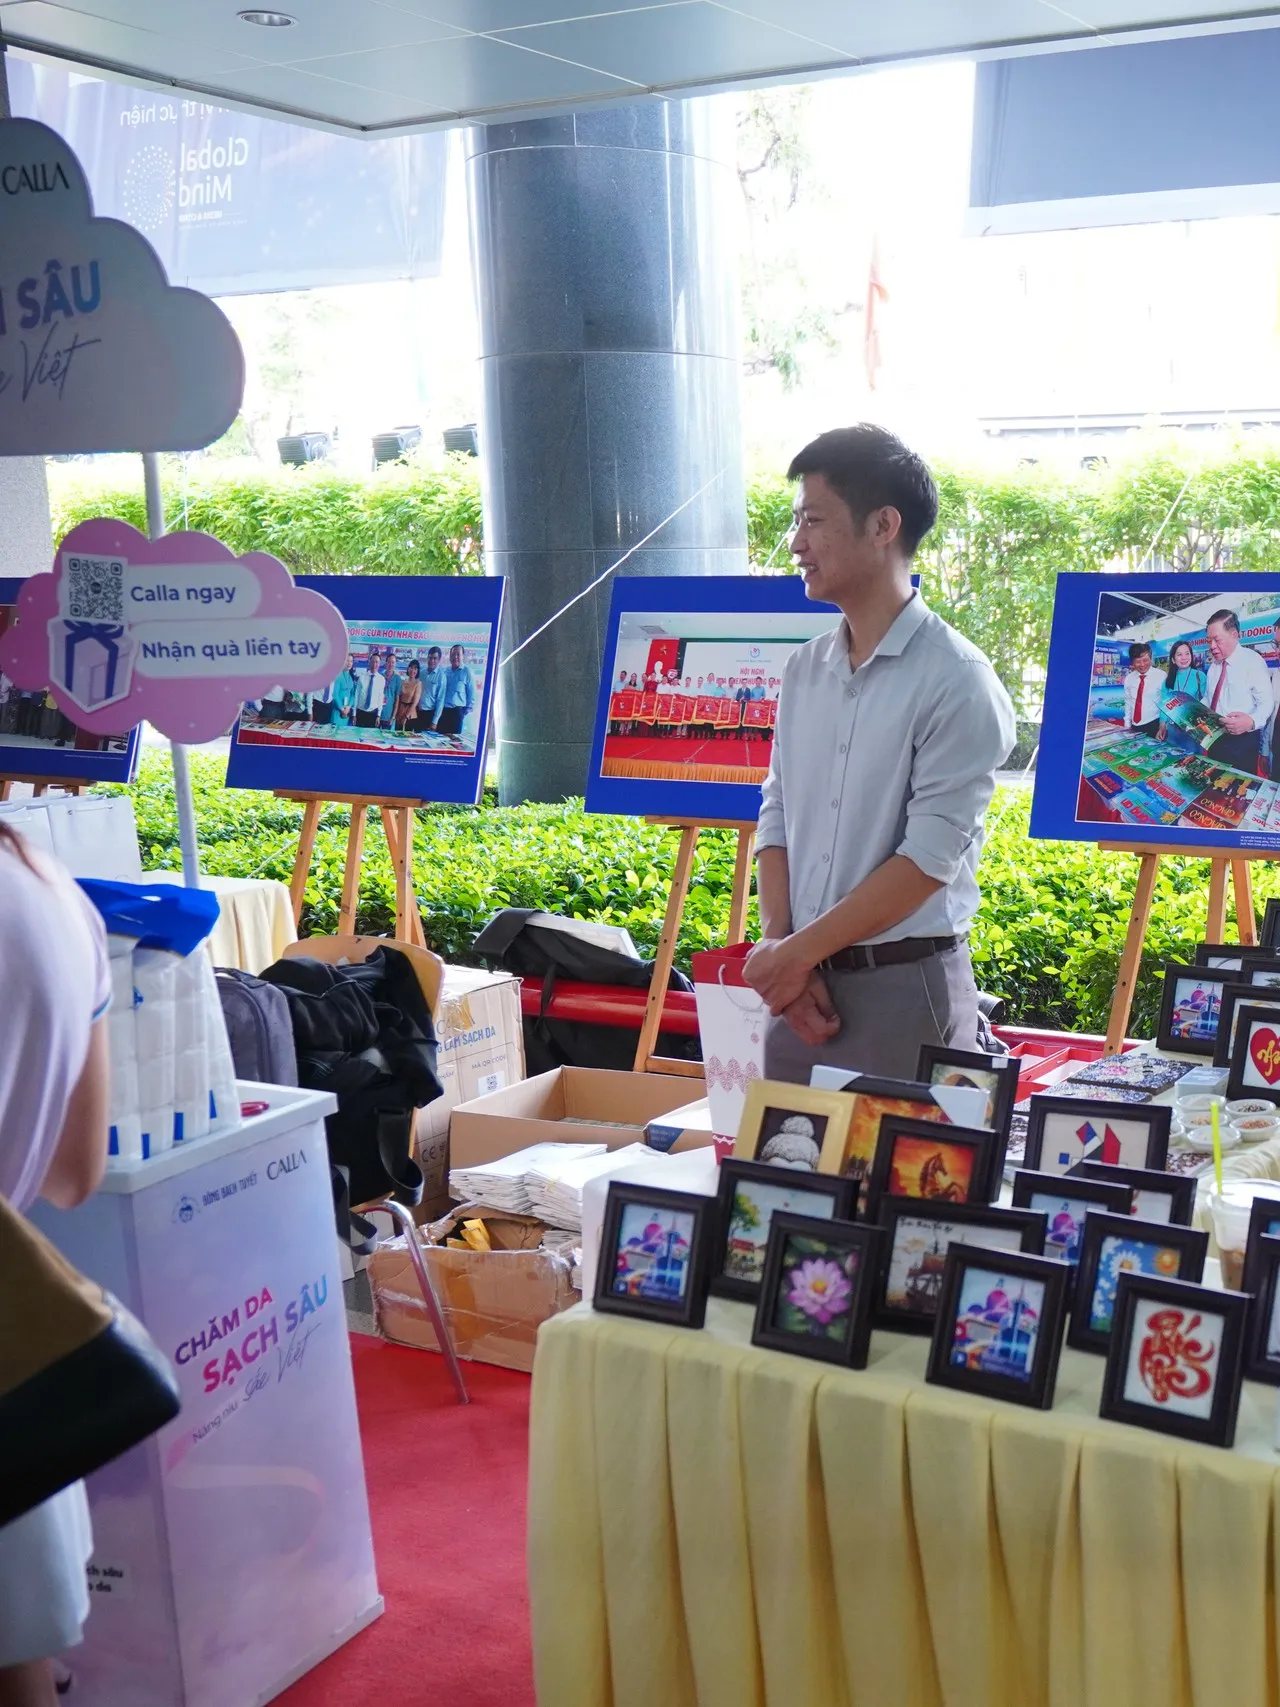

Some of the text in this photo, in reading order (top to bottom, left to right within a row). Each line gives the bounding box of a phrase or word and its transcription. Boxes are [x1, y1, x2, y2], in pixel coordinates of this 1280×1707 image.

[17, 258, 100, 330] SÂU
[20, 321, 101, 402] Việt
[130, 584, 236, 604] Calla ngay
[142, 637, 322, 662] Nhận quà liền tay
[485, 1026, 497, 1038] DA
[266, 1149, 308, 1181] CALLA
[174, 1285, 273, 1366] CHĂM DA
[202, 1273, 328, 1394] SẠCH SÂU
